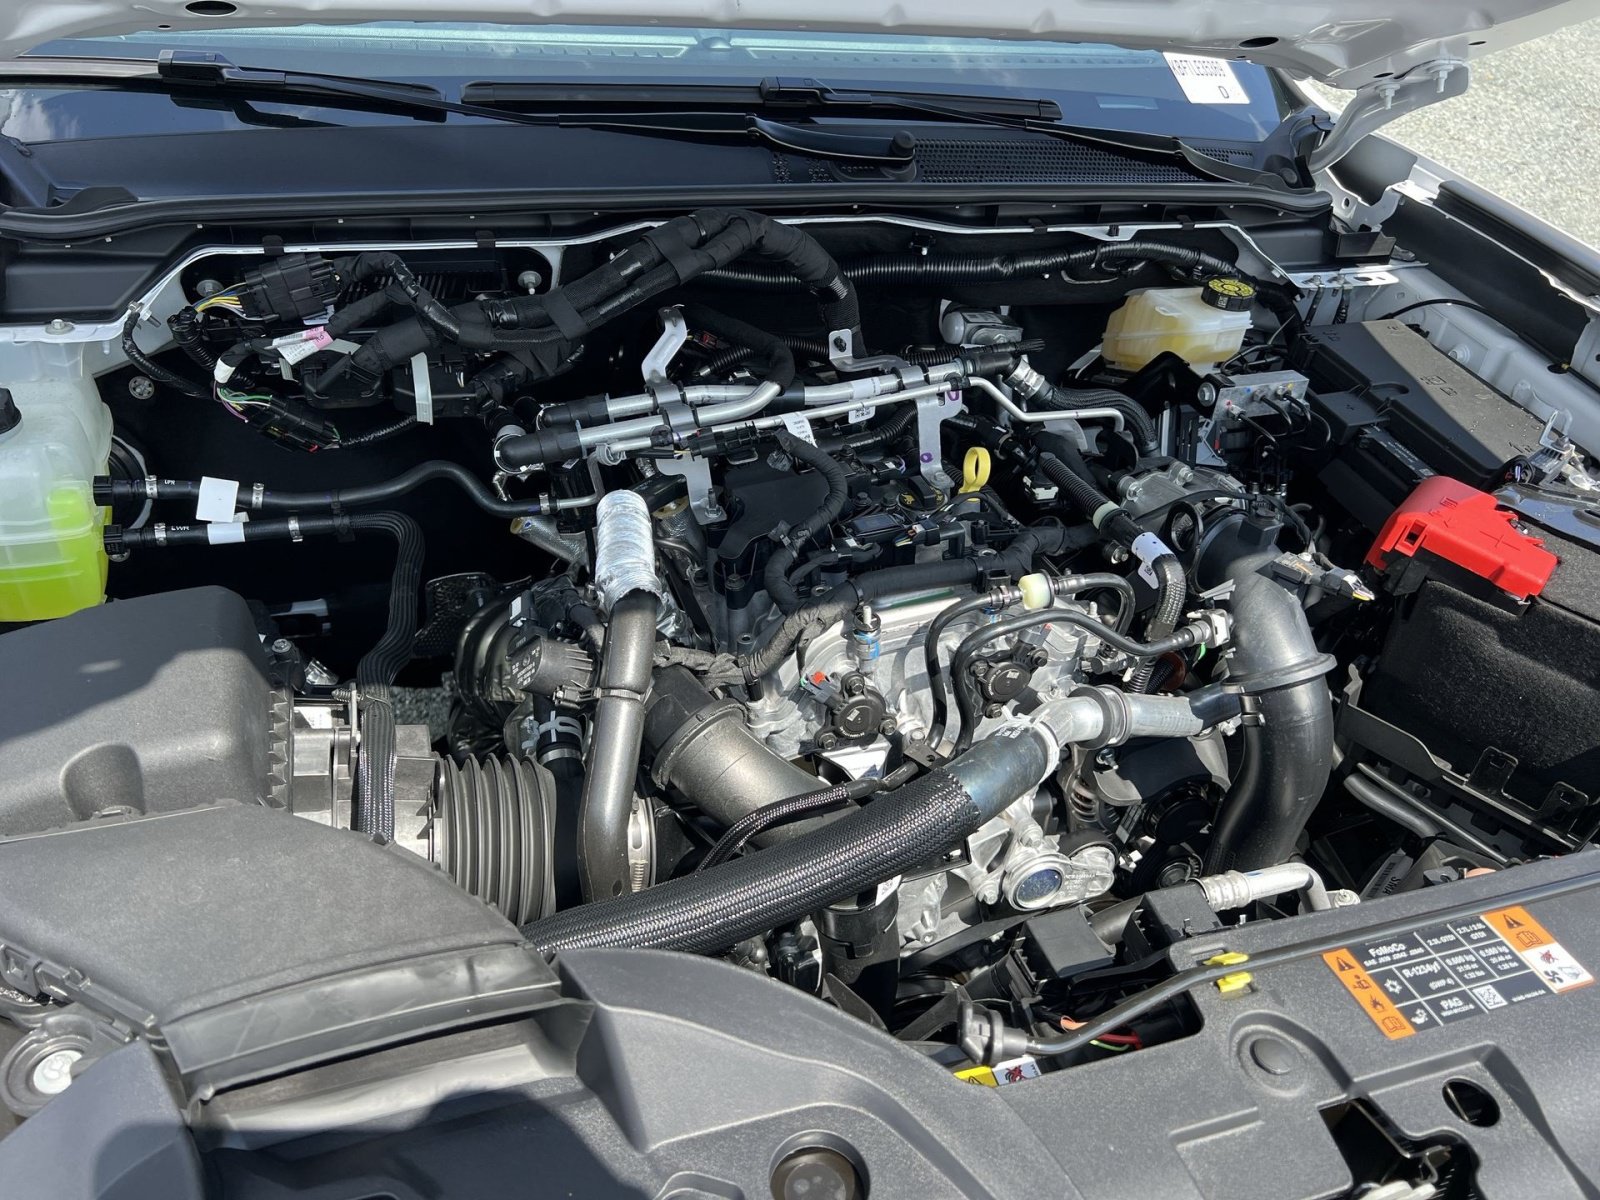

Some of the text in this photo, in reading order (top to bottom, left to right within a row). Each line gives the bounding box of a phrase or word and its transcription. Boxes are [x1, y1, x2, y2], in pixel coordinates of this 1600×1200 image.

[1368, 943, 1407, 958] FoMoCo
[1401, 960, 1441, 978] R-1234yf
[1440, 996, 1464, 1010] PAG
